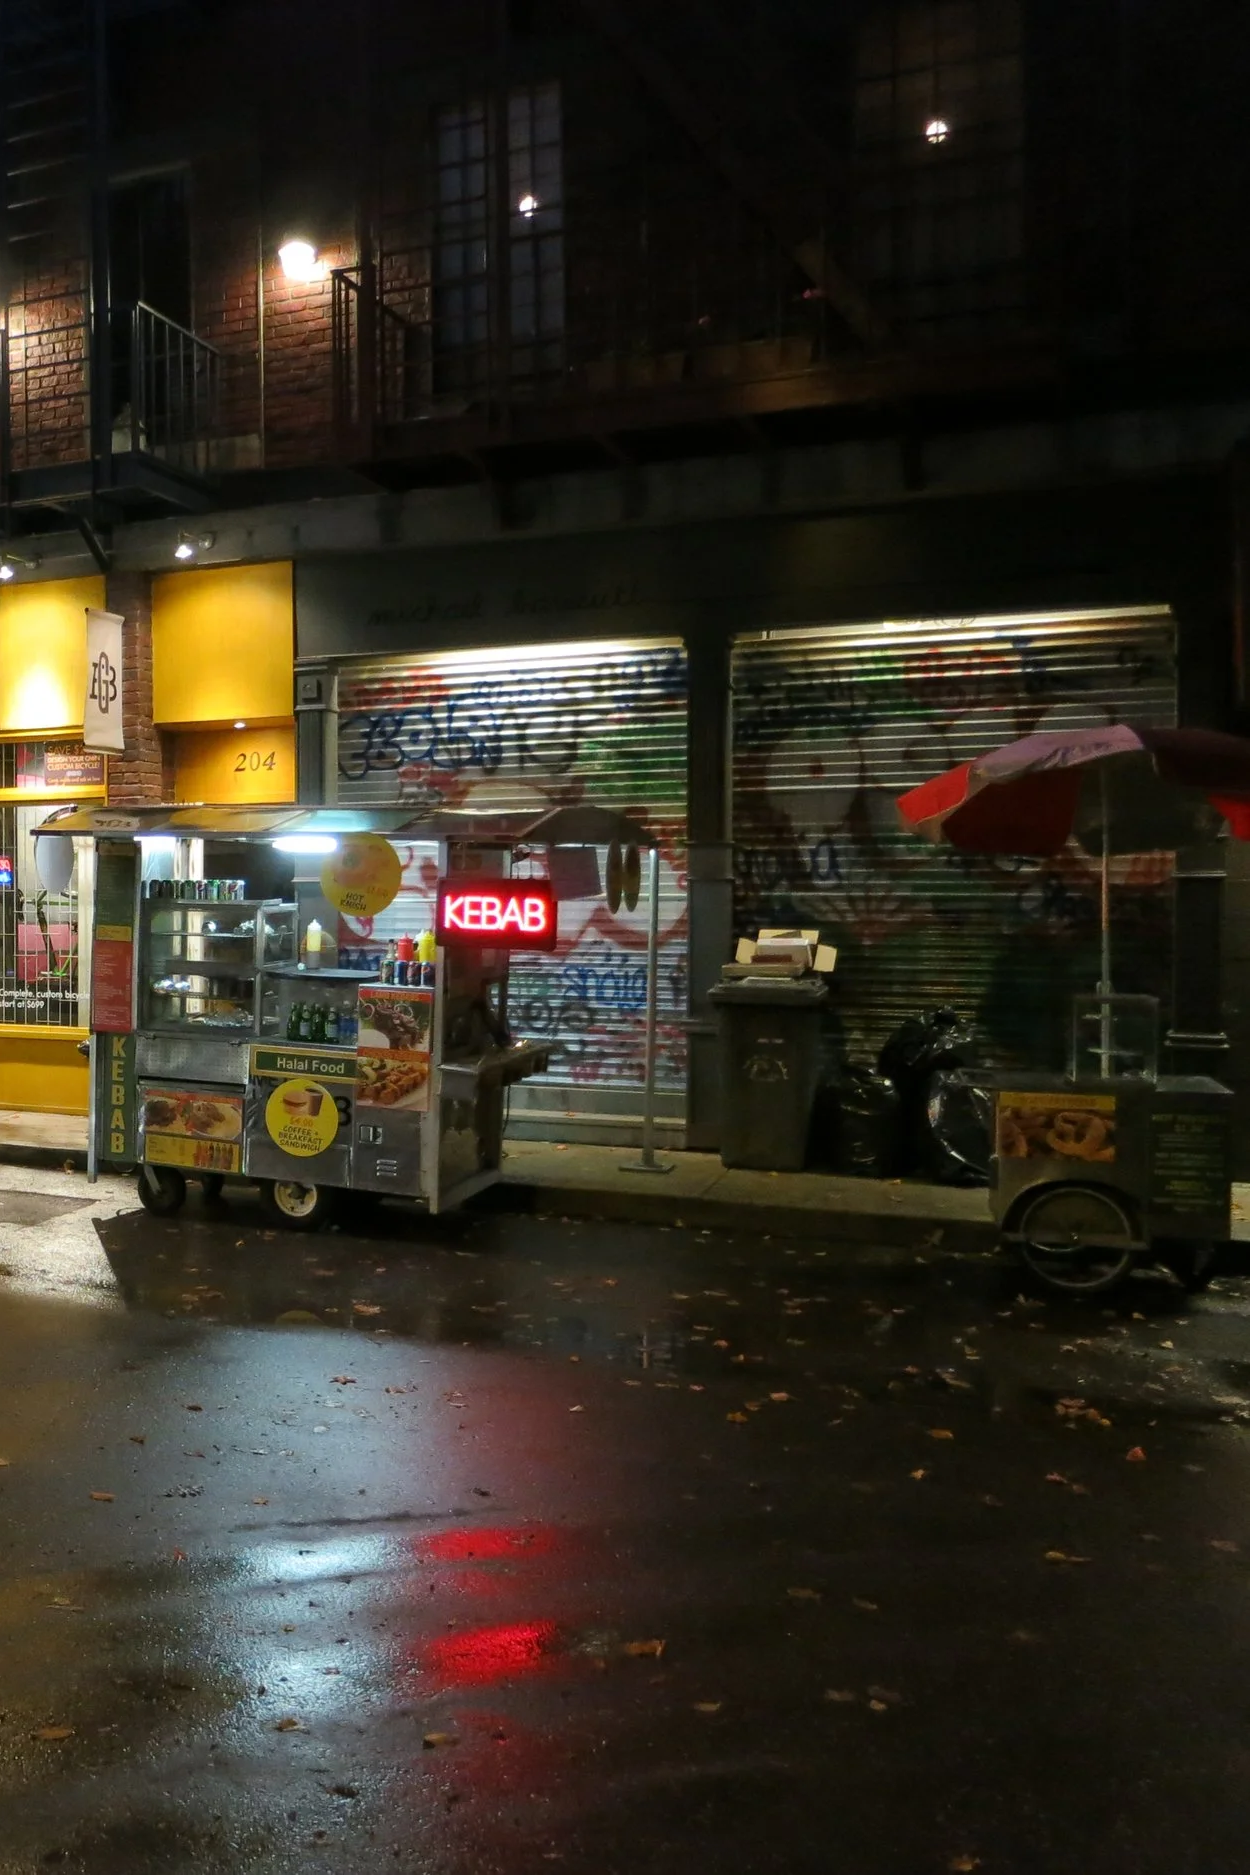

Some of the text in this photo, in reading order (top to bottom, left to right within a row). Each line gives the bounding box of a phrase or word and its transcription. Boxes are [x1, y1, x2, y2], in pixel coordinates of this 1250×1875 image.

[48, 745, 71, 756] SAVE
[233, 751, 276, 772] 204
[345, 892, 365, 903] HOT
[444, 895, 546, 932] KEBAB
[36, 990, 63, 999] custom
[27, 1000, 45, 1009] $699
[277, 1057, 345, 1074] Halal Food
[110, 1036, 126, 1154] KEBAB
[283, 1125, 313, 1137] COFFEE
[278, 1131, 323, 1146] BREAKFAST
[279, 1138, 321, 1152] SANDWICH
